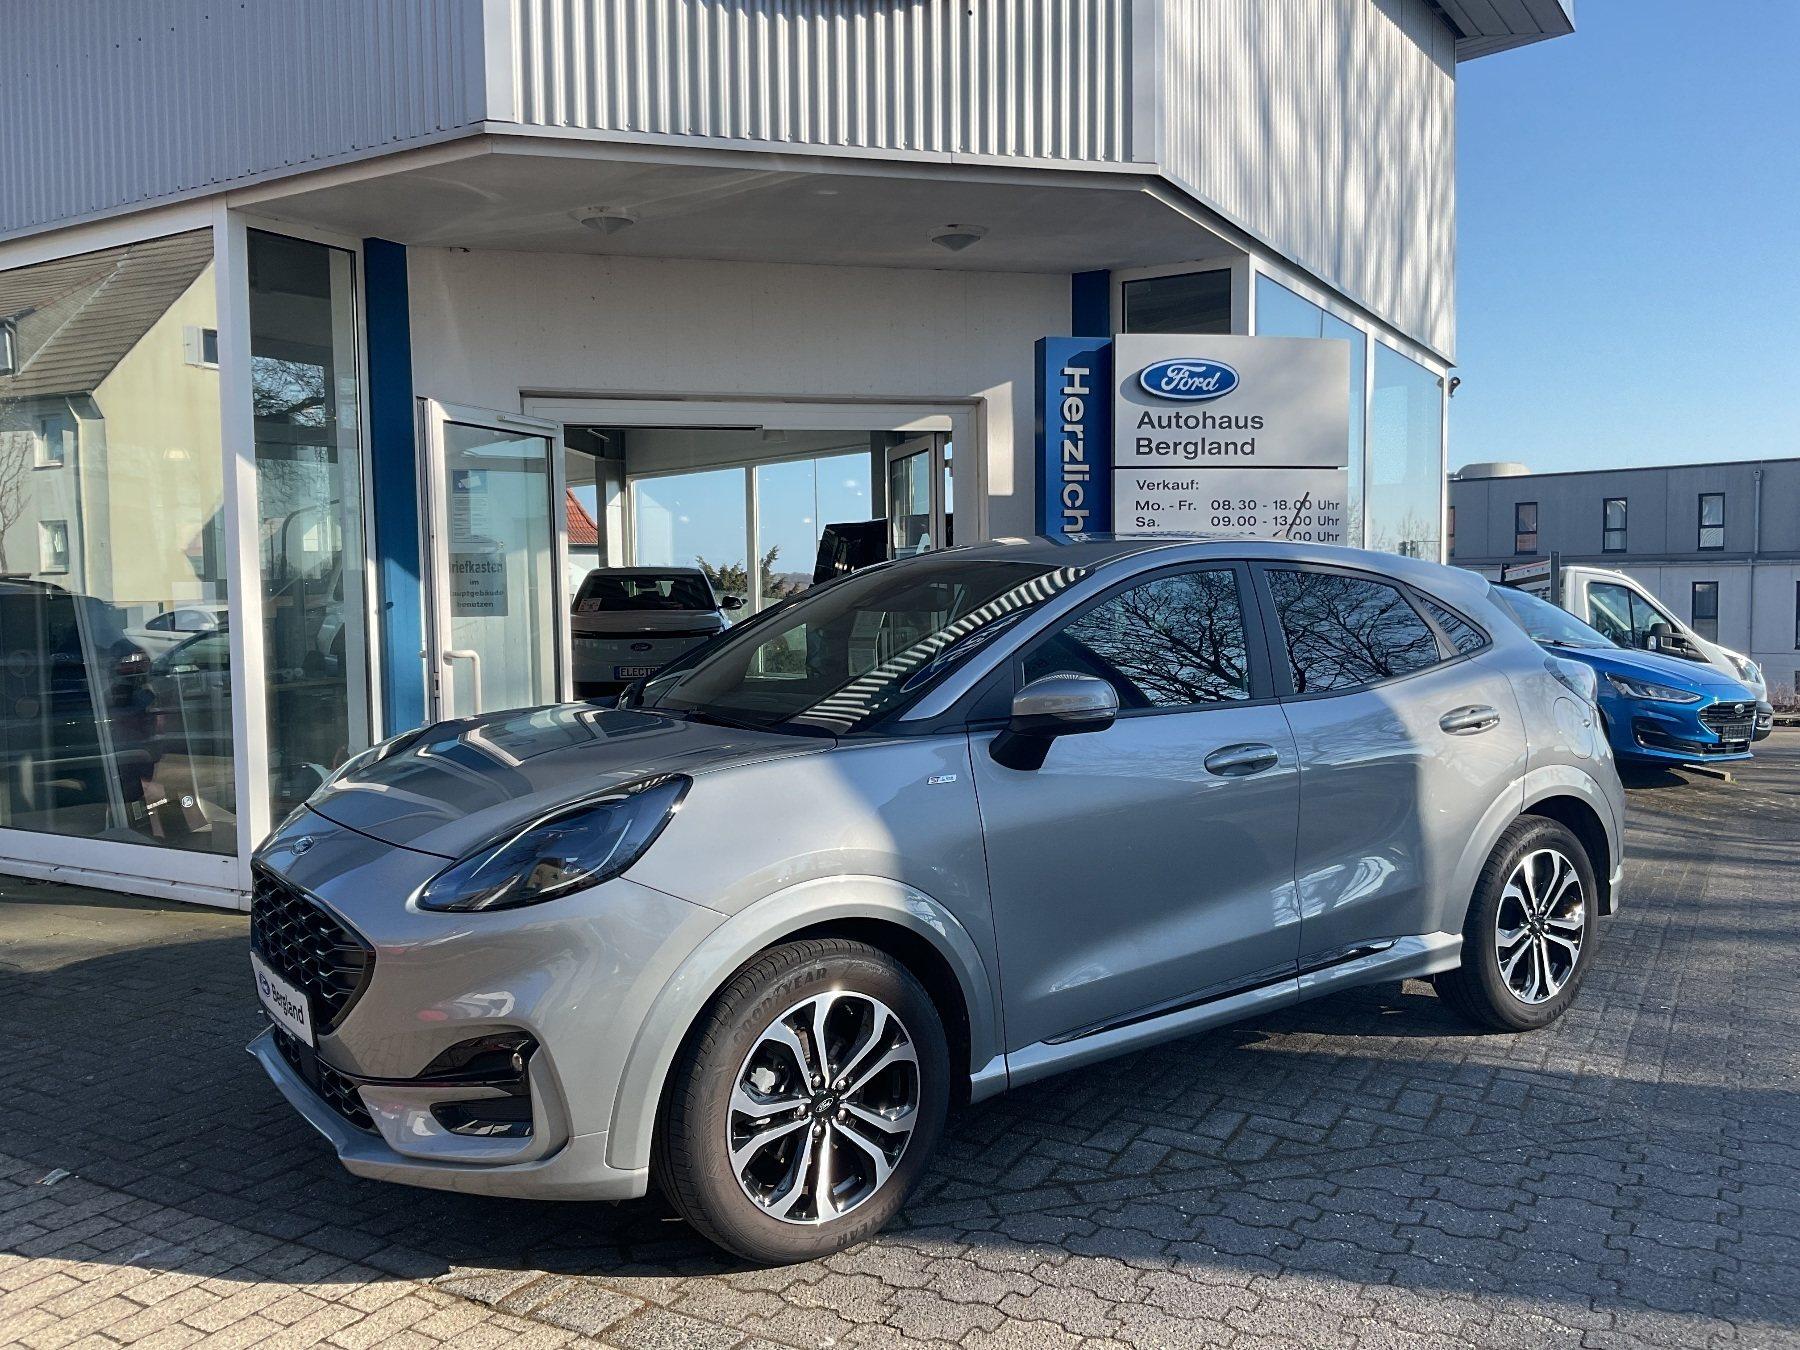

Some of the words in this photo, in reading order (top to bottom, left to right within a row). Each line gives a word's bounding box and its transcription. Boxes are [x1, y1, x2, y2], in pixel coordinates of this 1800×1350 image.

[1160, 364, 1220, 393] Ford
[1136, 411, 1264, 430] Autohaus
[1062, 367, 1090, 532] Herzlich
[1135, 437, 1256, 460] Bergland
[1136, 479, 1200, 491] Verkauf:
[1135, 500, 1165, 511] Mo.
[1178, 500, 1197, 511] Fr.
[1211, 499, 1257, 511] 08.30
[1272, 499, 1312, 511] 18.00
[1317, 500, 1340, 511] Uhr
[1135, 516, 1160, 527] Sa.
[1211, 515, 1257, 527] 09.00
[1272, 515, 1312, 527] 13.00
[1317, 515, 1340, 527] Uhr
[1317, 531, 1340, 542] Uhr
[449, 560, 503, 574] riefkasten
[270, 982, 305, 1026] Bergland
